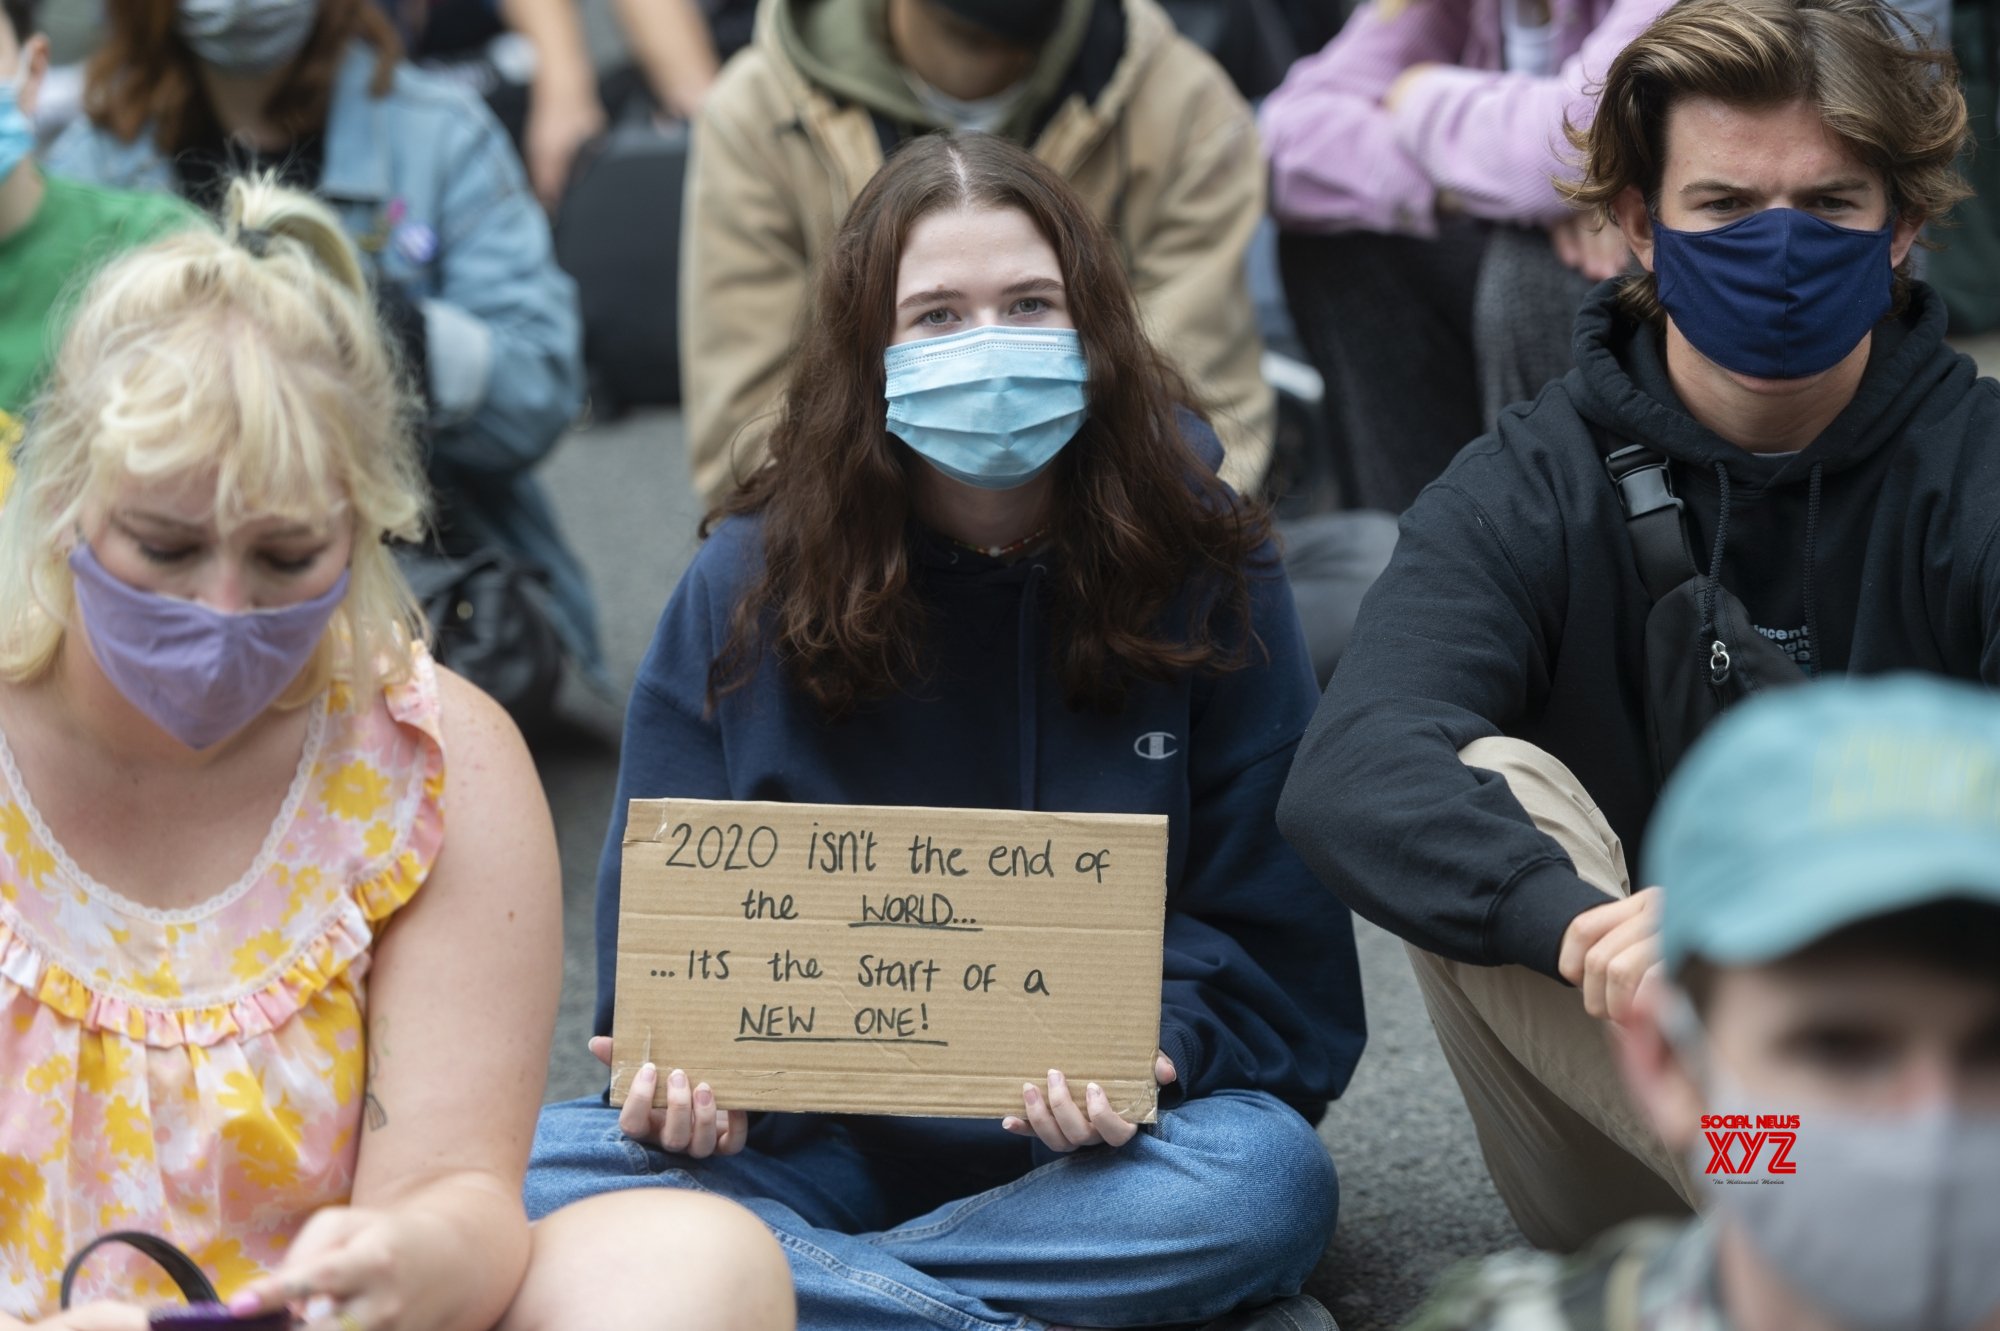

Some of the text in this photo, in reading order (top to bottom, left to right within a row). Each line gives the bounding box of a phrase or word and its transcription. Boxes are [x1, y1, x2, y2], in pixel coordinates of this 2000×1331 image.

[666, 822, 1110, 883] 2020 isn't the end of
[741, 889, 977, 926] the WORLD...
[767, 950, 823, 982] the
[1023, 969, 1050, 997] a
[739, 1003, 929, 1037] NEW ONE!
